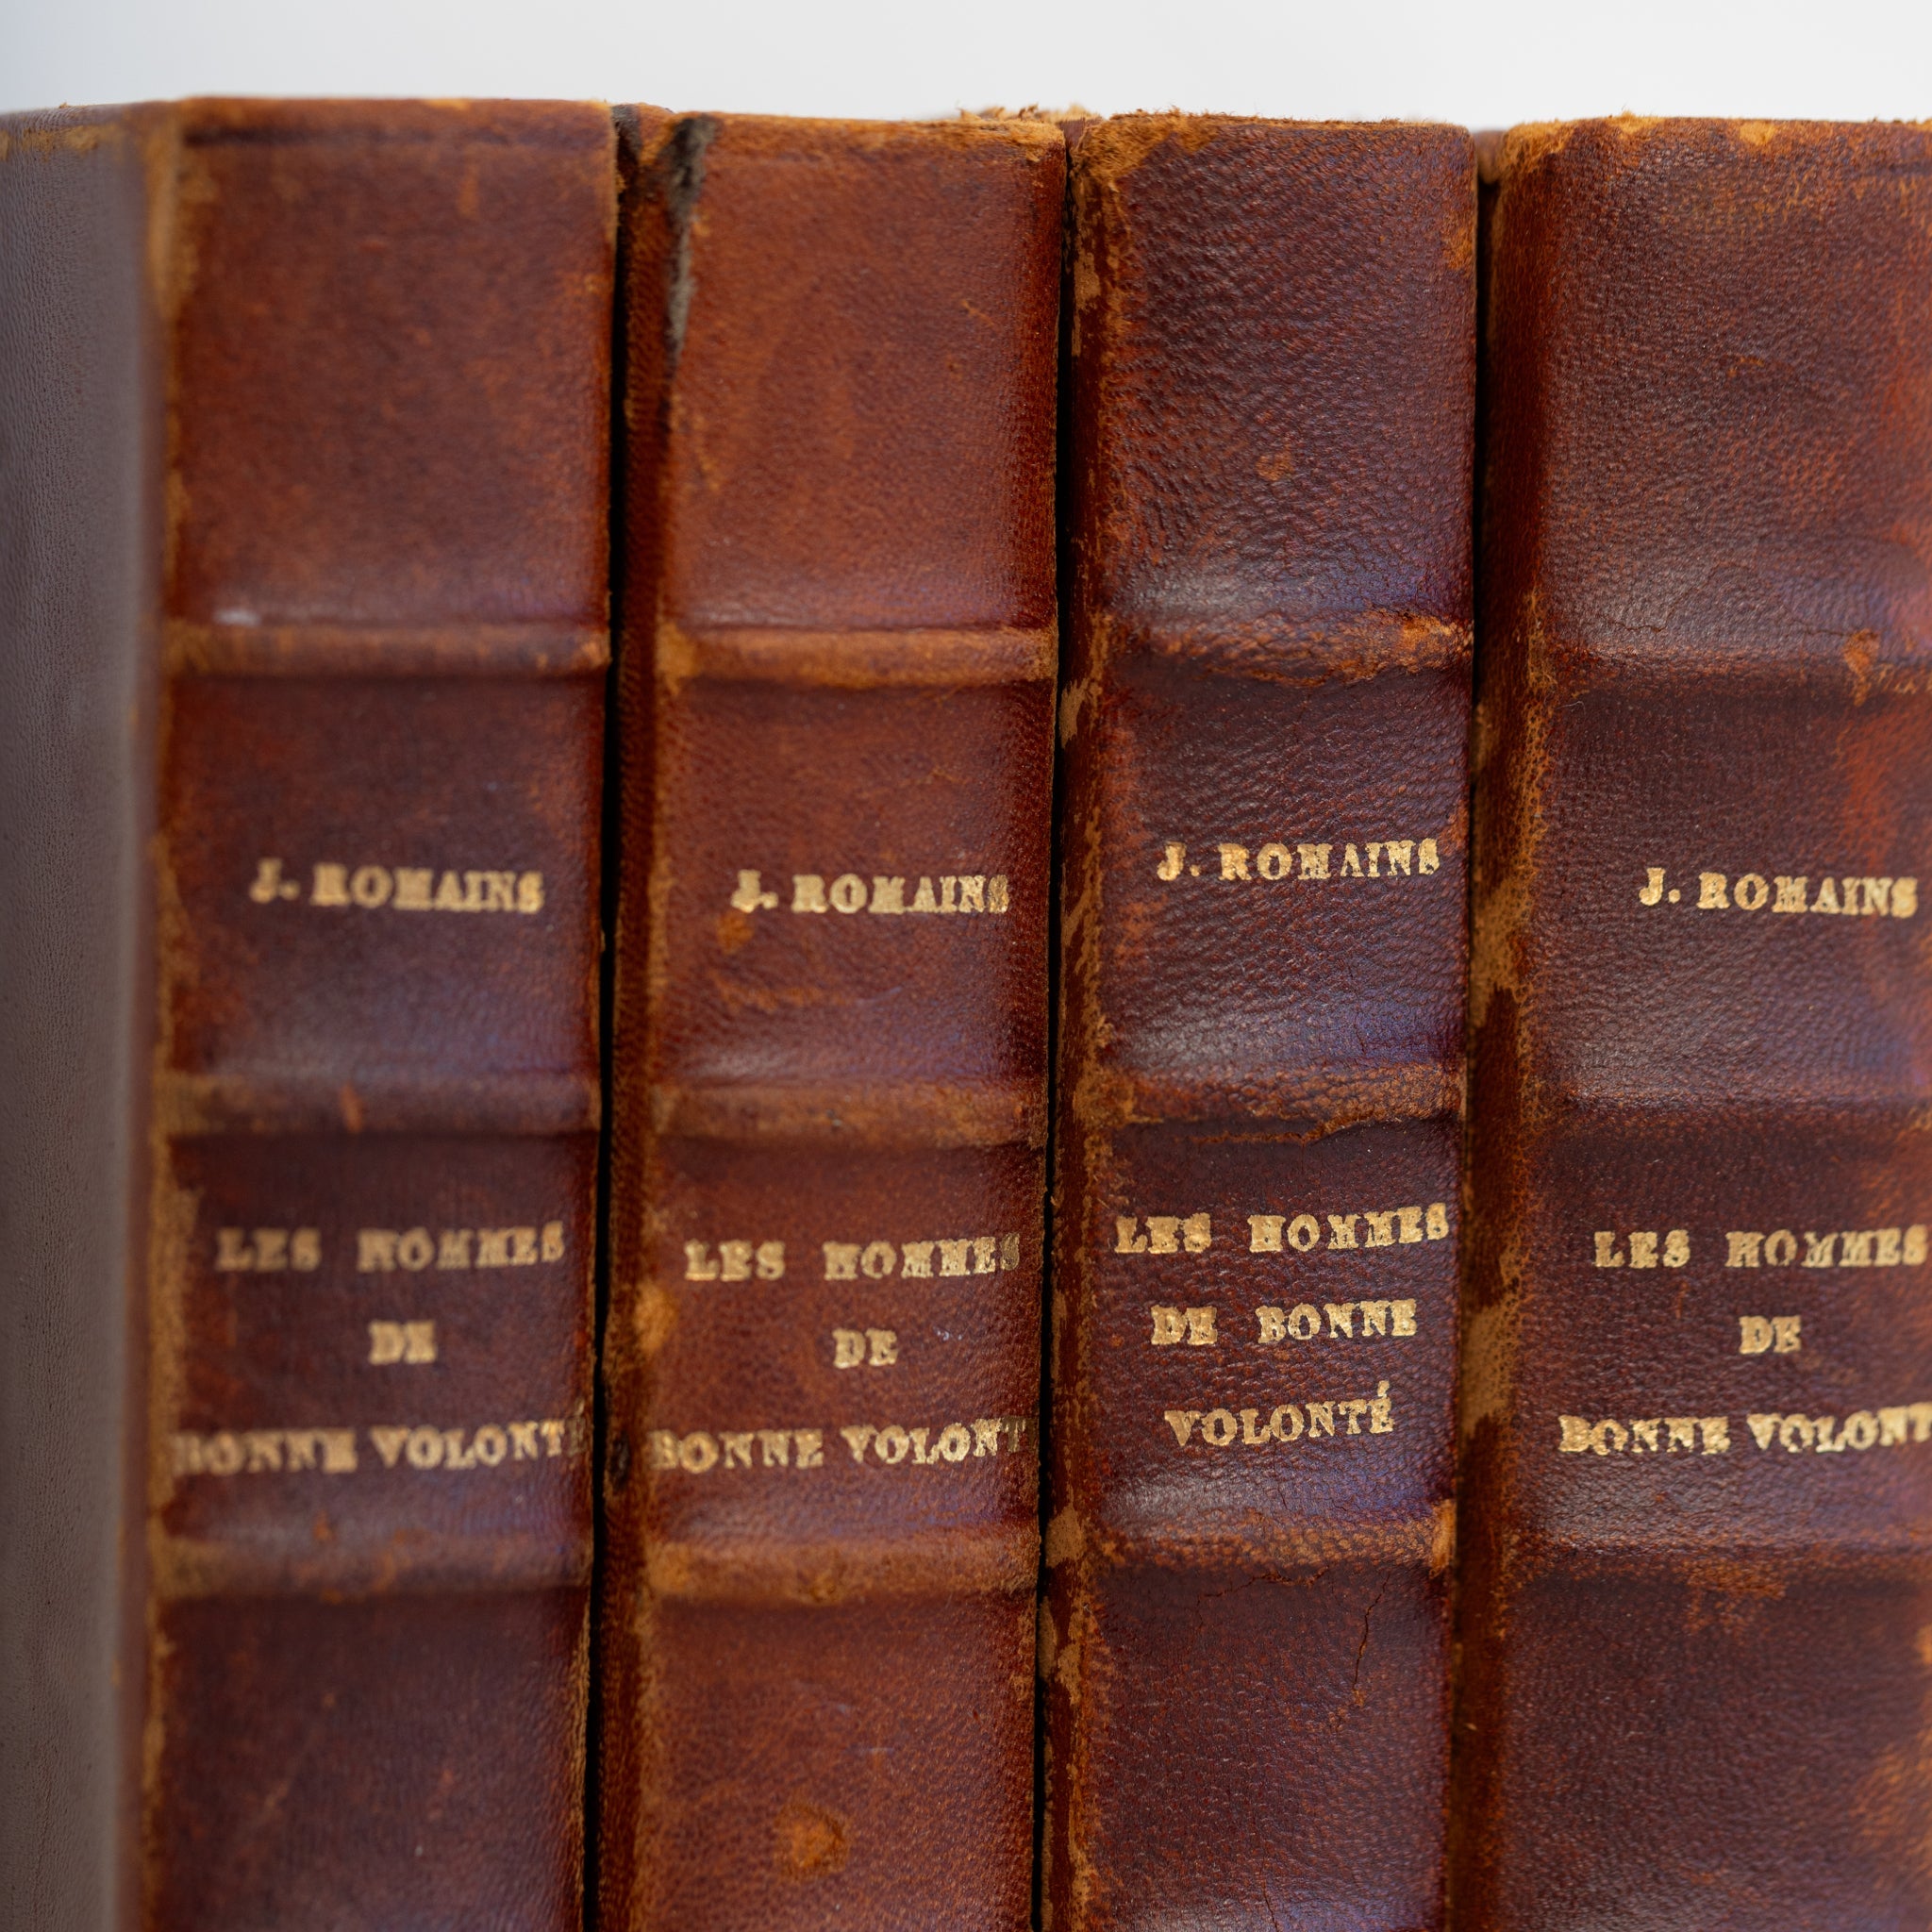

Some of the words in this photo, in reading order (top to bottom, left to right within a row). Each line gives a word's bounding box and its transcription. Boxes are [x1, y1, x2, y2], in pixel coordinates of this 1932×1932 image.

[1157, 841, 1201, 881] J.
[1219, 838, 1440, 881] ROMAINS
[250, 859, 300, 903] J.
[310, 863, 544, 914] ROMAINS
[731, 870, 778, 912] J.
[791, 874, 1010, 914] ROMAINS
[1639, 867, 1681, 907] J.
[1696, 871, 1919, 919] ROMAINS
[215, 1226, 322, 1271] LES
[356, 1222, 566, 1272] HOMMES
[1114, 1212, 1212, 1255] LES
[1247, 1203, 1450, 1254] HOMMES
[1593, 1229, 1691, 1270] LES
[1724, 1225, 1929, 1268] HOMMES
[684, 1240, 786, 1281] LES
[822, 1233, 1021, 1281] HOMMES
[369, 1321, 438, 1365] DE
[1150, 1305, 1218, 1346] DE
[1257, 1299, 1418, 1345] BONNE
[1739, 1316, 1802, 1355] DE
[832, 1328, 899, 1369] DE
[1164, 1380, 1394, 1447] VOLONTÉ
[1557, 1416, 1731, 1455] BONNE
[174, 1428, 358, 1474] BONNE
[646, 1429, 824, 1474] BONNE
[839, 1416, 1039, 1466] VOLONT
